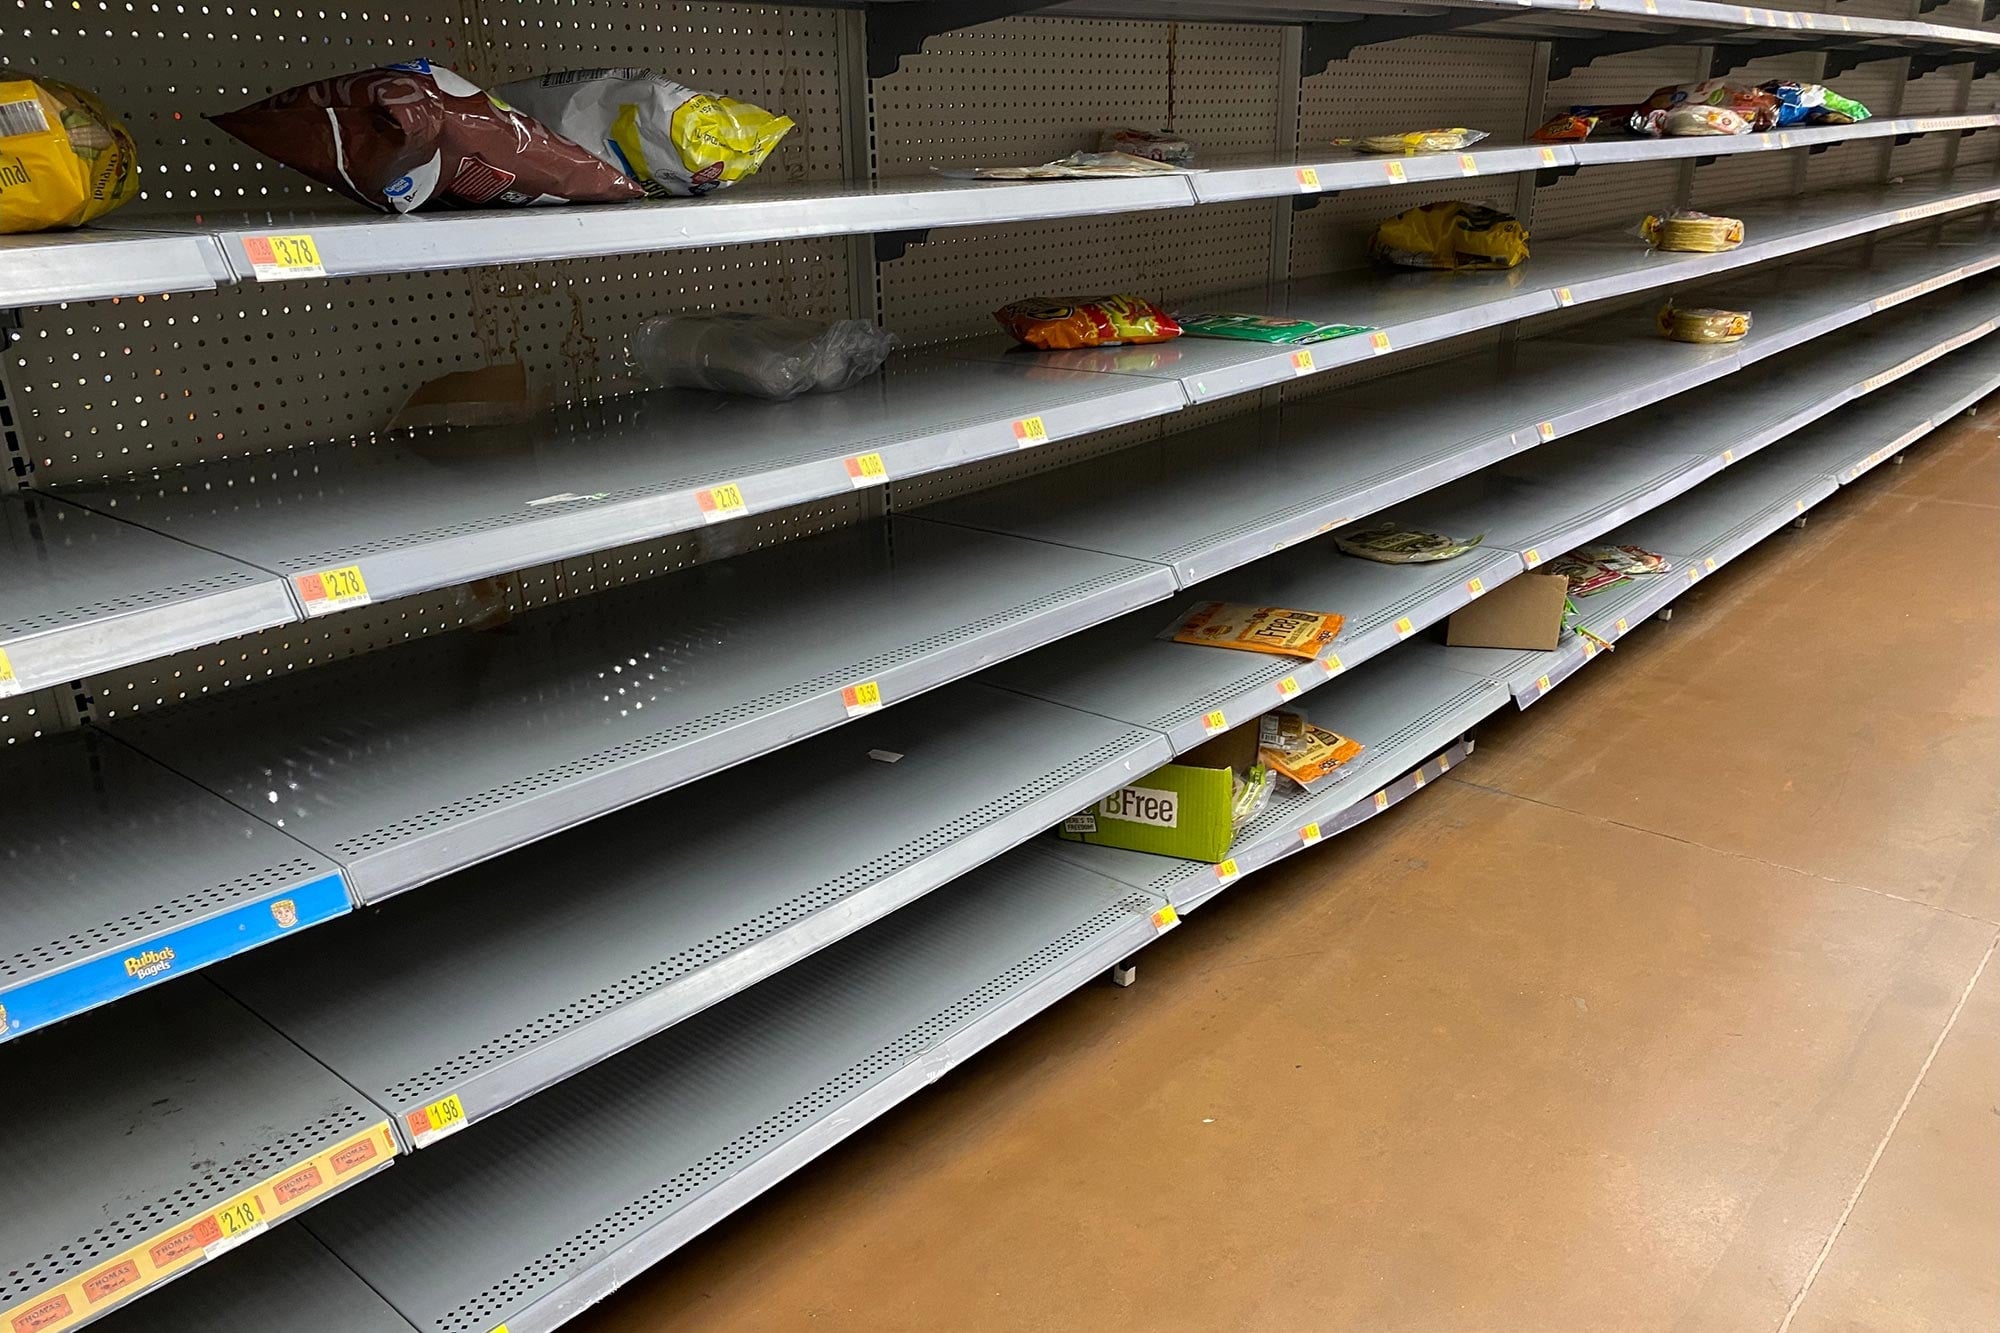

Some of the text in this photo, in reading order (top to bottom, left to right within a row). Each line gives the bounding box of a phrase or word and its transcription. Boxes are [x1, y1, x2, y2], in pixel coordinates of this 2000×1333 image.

[0, 156, 31, 195] inal
[325, 570, 360, 597] $2.78
[1105, 788, 1173, 822] BFree
[124, 946, 175, 977] Bubba's
[137, 960, 171, 980] Bagels
